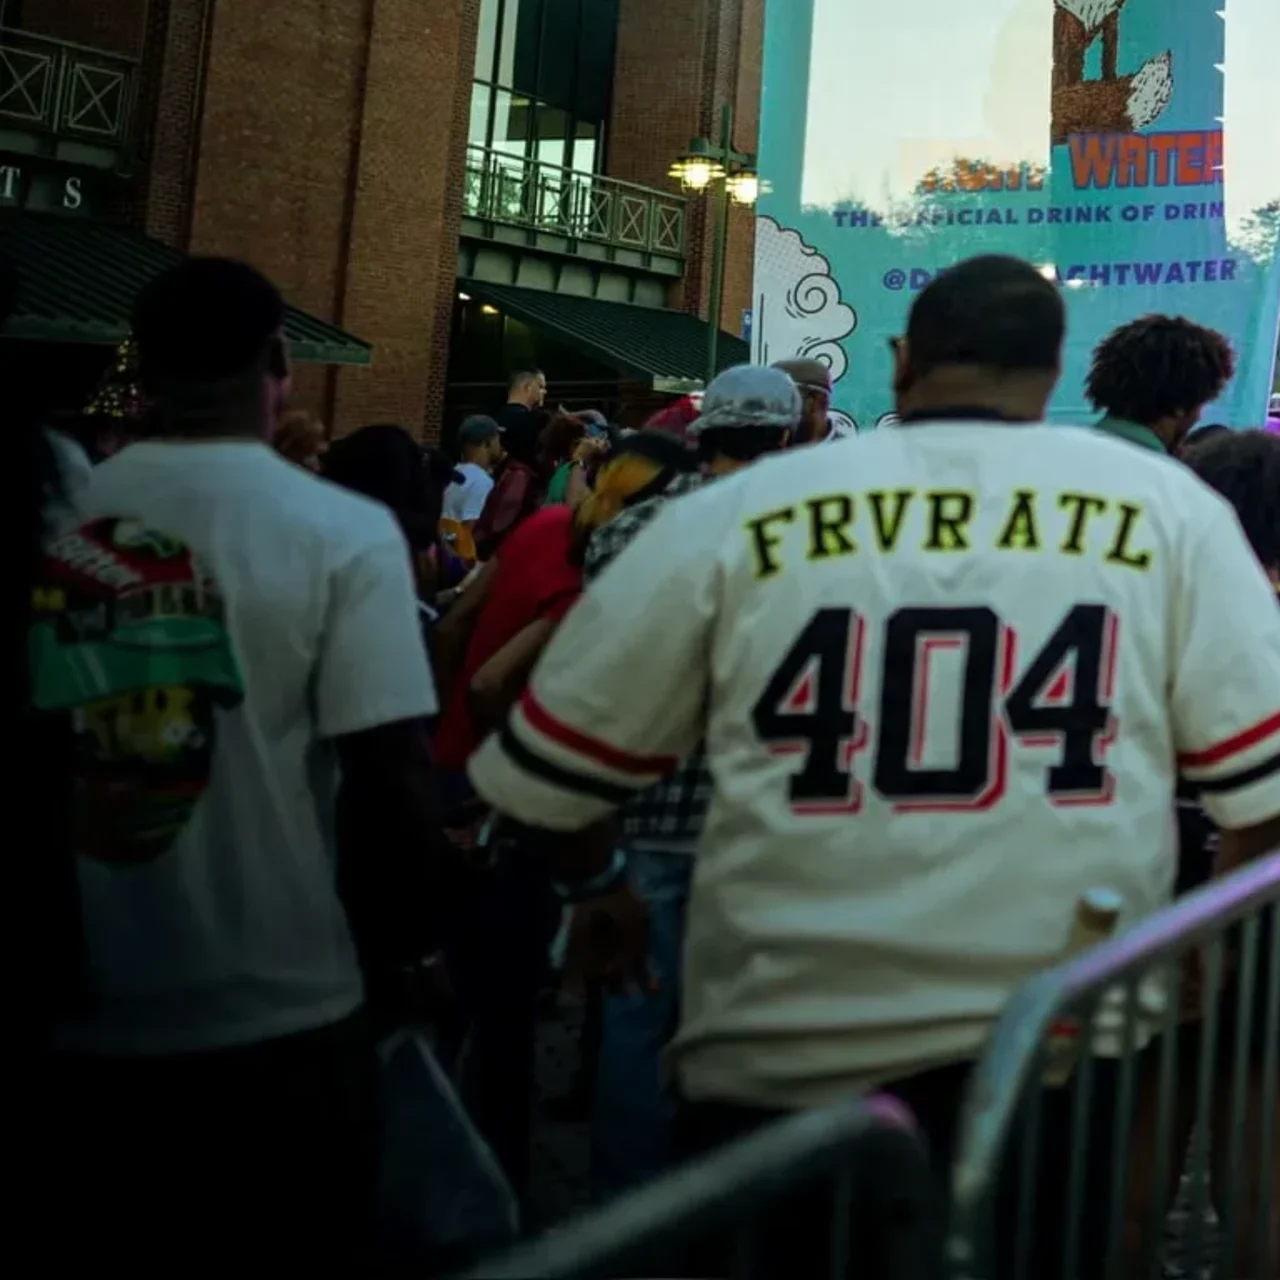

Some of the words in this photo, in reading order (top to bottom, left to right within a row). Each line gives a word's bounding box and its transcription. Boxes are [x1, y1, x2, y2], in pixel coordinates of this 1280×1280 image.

[1027, 205, 1112, 224] DRINK
[1121, 205, 1155, 221] OF
[745, 488, 974, 579] FRVR
[997, 489, 1153, 571] ATL
[751, 603, 1118, 815] 404
